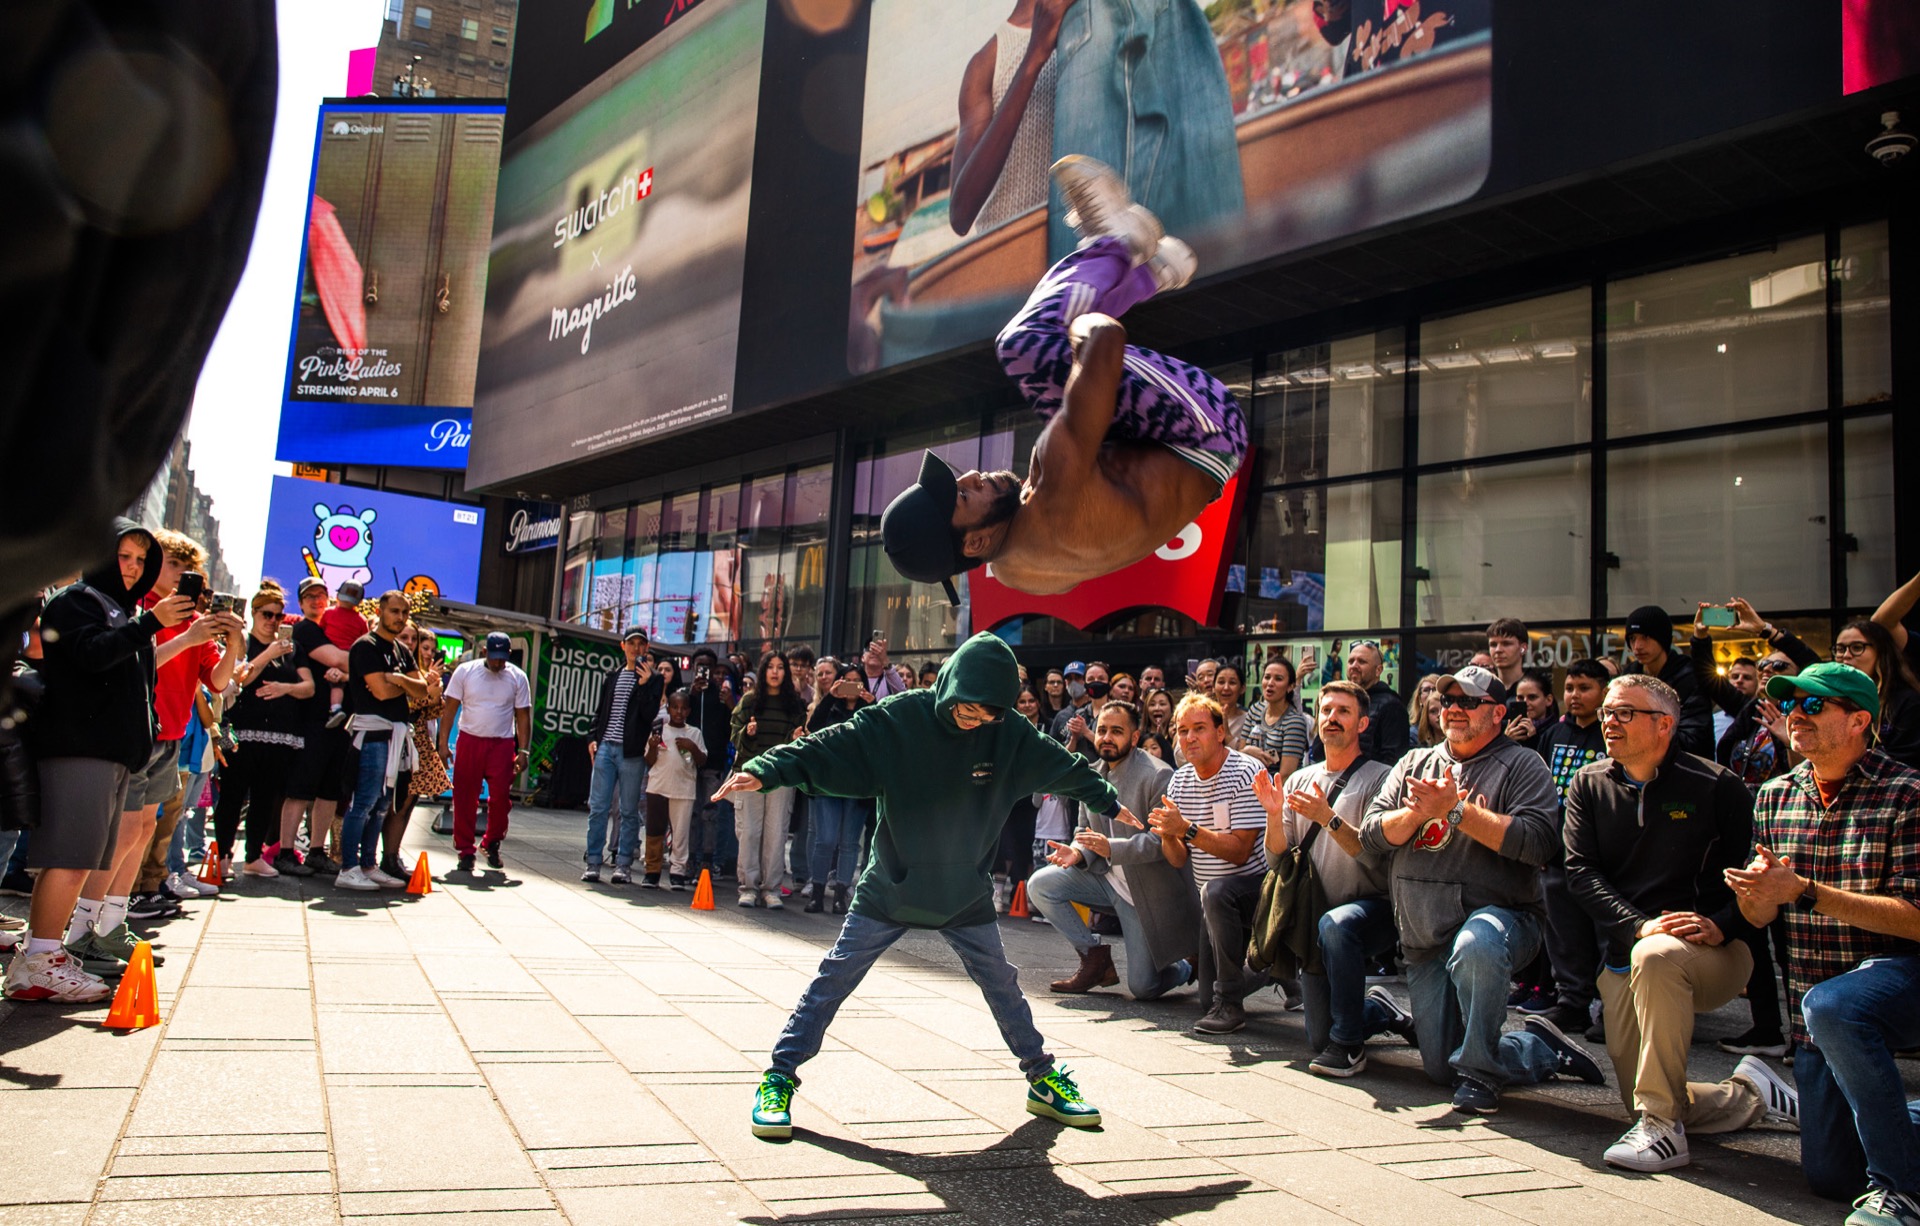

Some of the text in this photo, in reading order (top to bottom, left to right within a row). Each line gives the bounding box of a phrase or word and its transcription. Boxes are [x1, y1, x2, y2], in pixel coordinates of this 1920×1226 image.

[351, 125, 384, 135] Original
[553, 175, 636, 249] swatch
[336, 348, 356, 356] RISE
[370, 349, 388, 357] THE
[299, 355, 402, 382] Pink Ladies
[297, 384, 398, 397] STREAMING APRIL 6
[546, 663, 606, 716] BROAD
